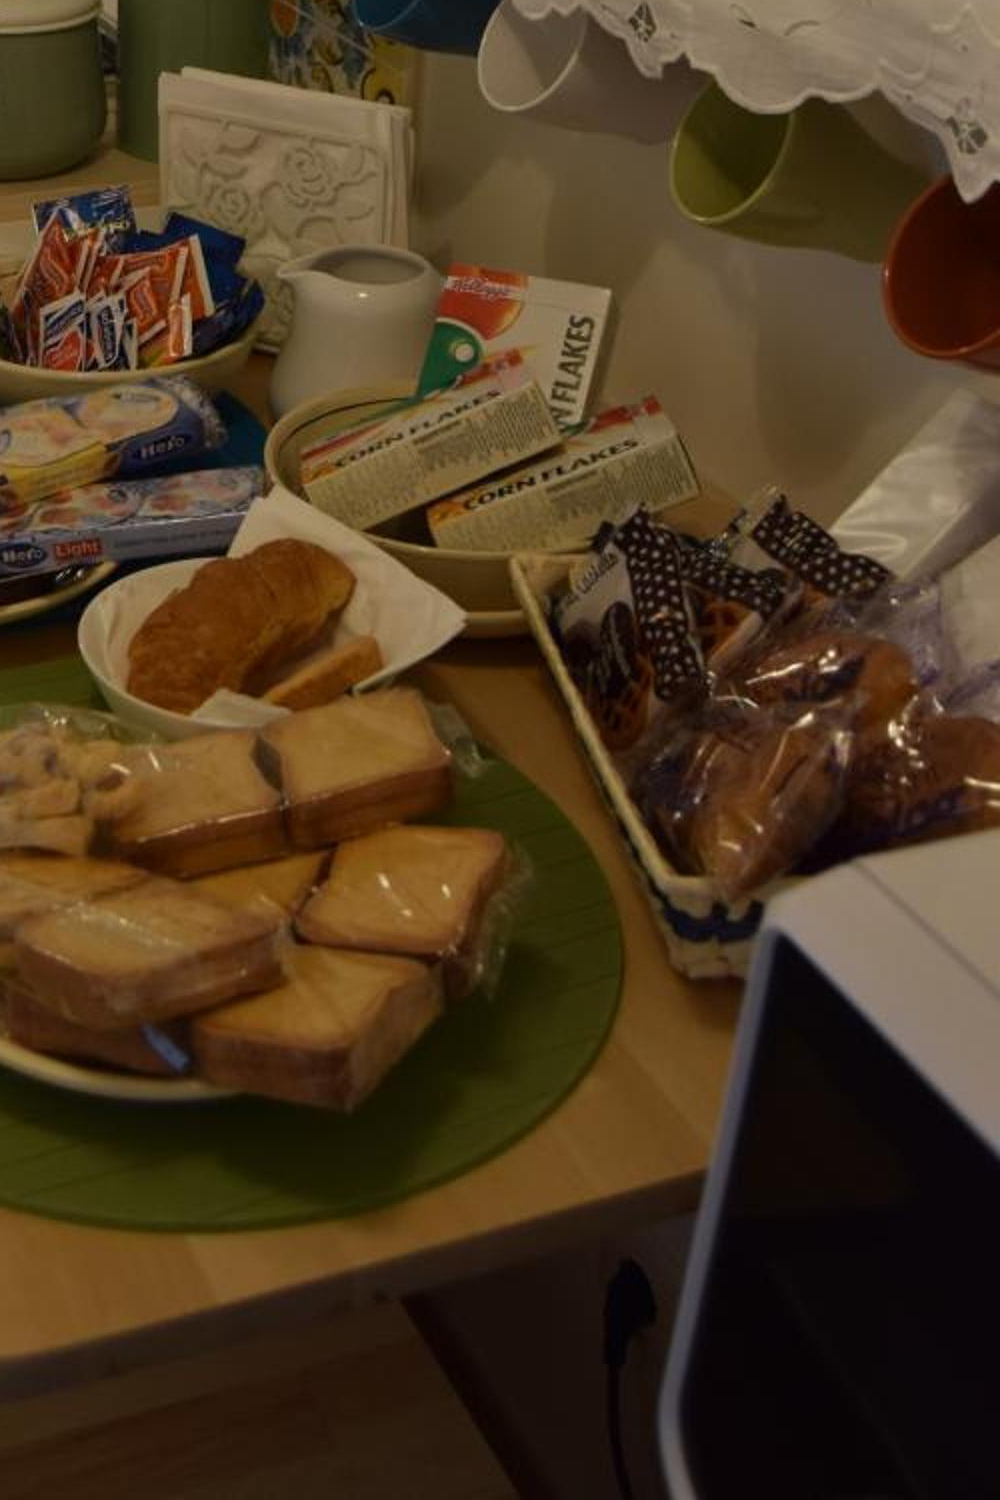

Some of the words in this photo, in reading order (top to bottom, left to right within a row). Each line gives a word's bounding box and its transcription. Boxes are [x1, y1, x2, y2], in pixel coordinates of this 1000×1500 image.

[551, 314, 595, 405] FLAKES
[137, 434, 186, 460] Hero
[335, 432, 403, 468] CORN
[409, 389, 501, 435] FLAKES
[462, 475, 535, 511] CORN
[541, 438, 638, 482] FLAKES
[1, 545, 45, 568] Hero
[54, 538, 101, 561] Light
